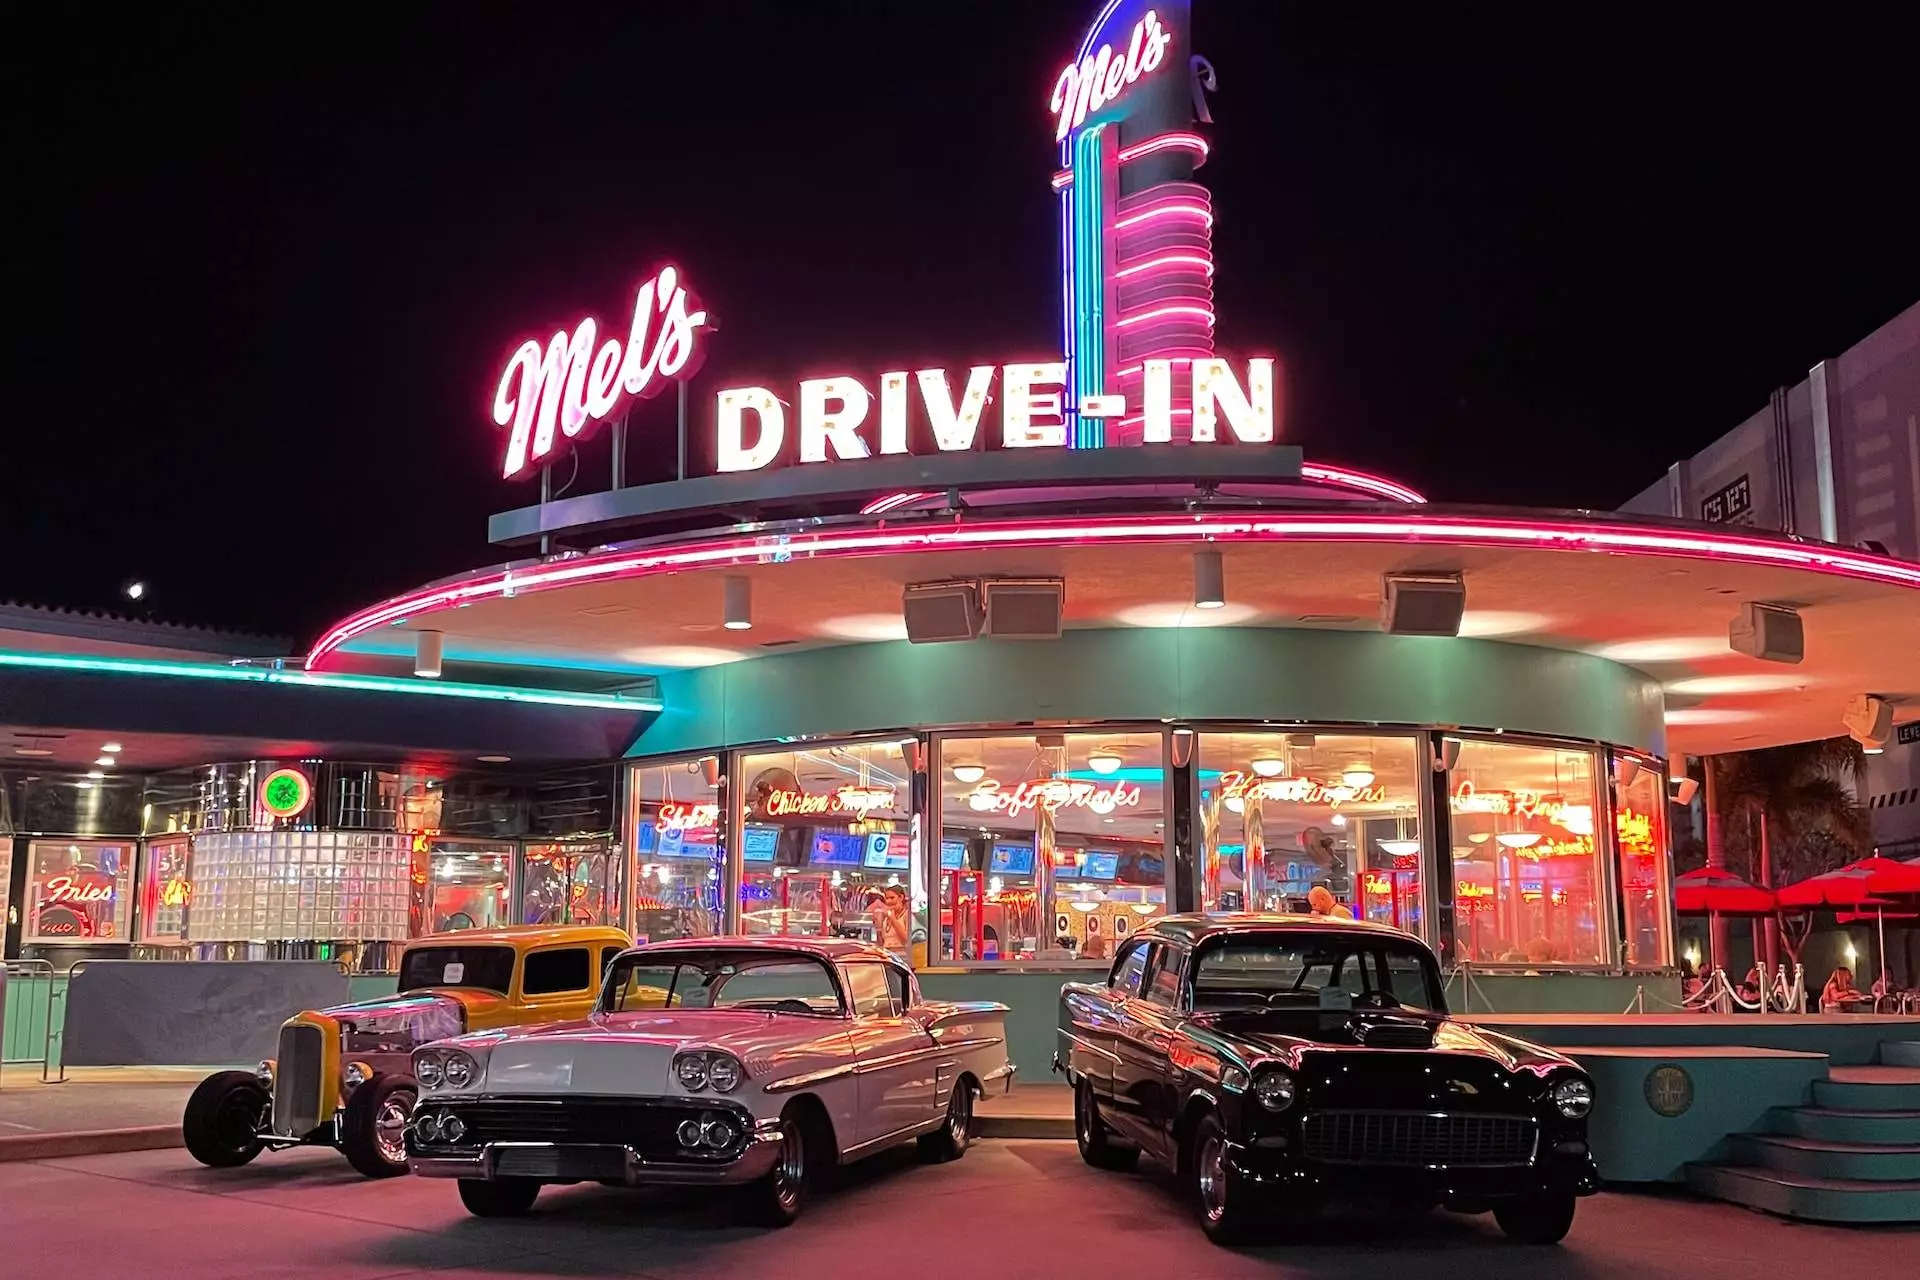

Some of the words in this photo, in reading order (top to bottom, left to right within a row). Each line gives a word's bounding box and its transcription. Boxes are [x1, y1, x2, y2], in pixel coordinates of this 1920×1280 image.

[1051, 10, 1170, 142] Mel's
[494, 266, 706, 479] Mel's
[716, 357, 1274, 473] DRIVE-IN
[766, 789, 829, 816] Chicken
[972, 779, 1041, 817] Soft
[47, 876, 113, 902] Fries
